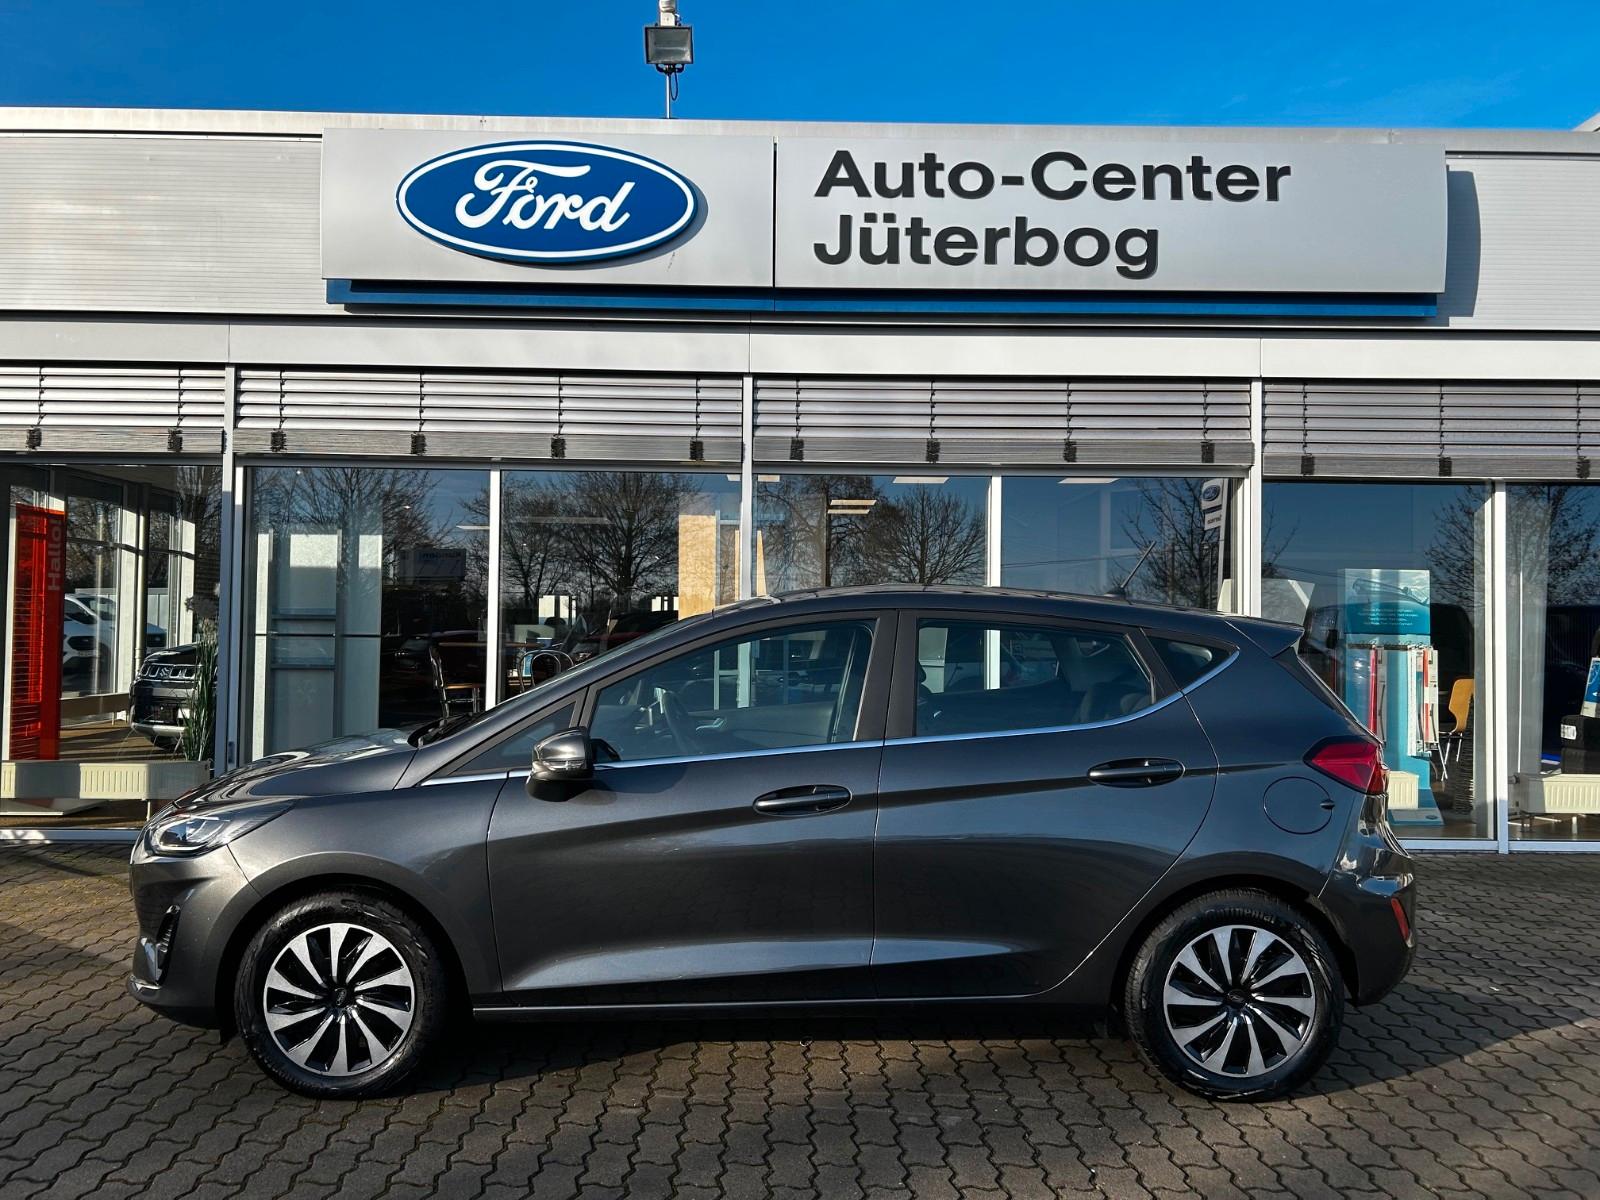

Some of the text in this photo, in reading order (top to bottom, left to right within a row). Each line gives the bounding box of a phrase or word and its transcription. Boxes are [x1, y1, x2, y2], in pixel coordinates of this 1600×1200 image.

[454, 159, 637, 232] Ford
[814, 150, 1292, 203] Auto-Center
[813, 211, 1160, 280] Jüterbog
[47, 519, 61, 591] Hallo!
